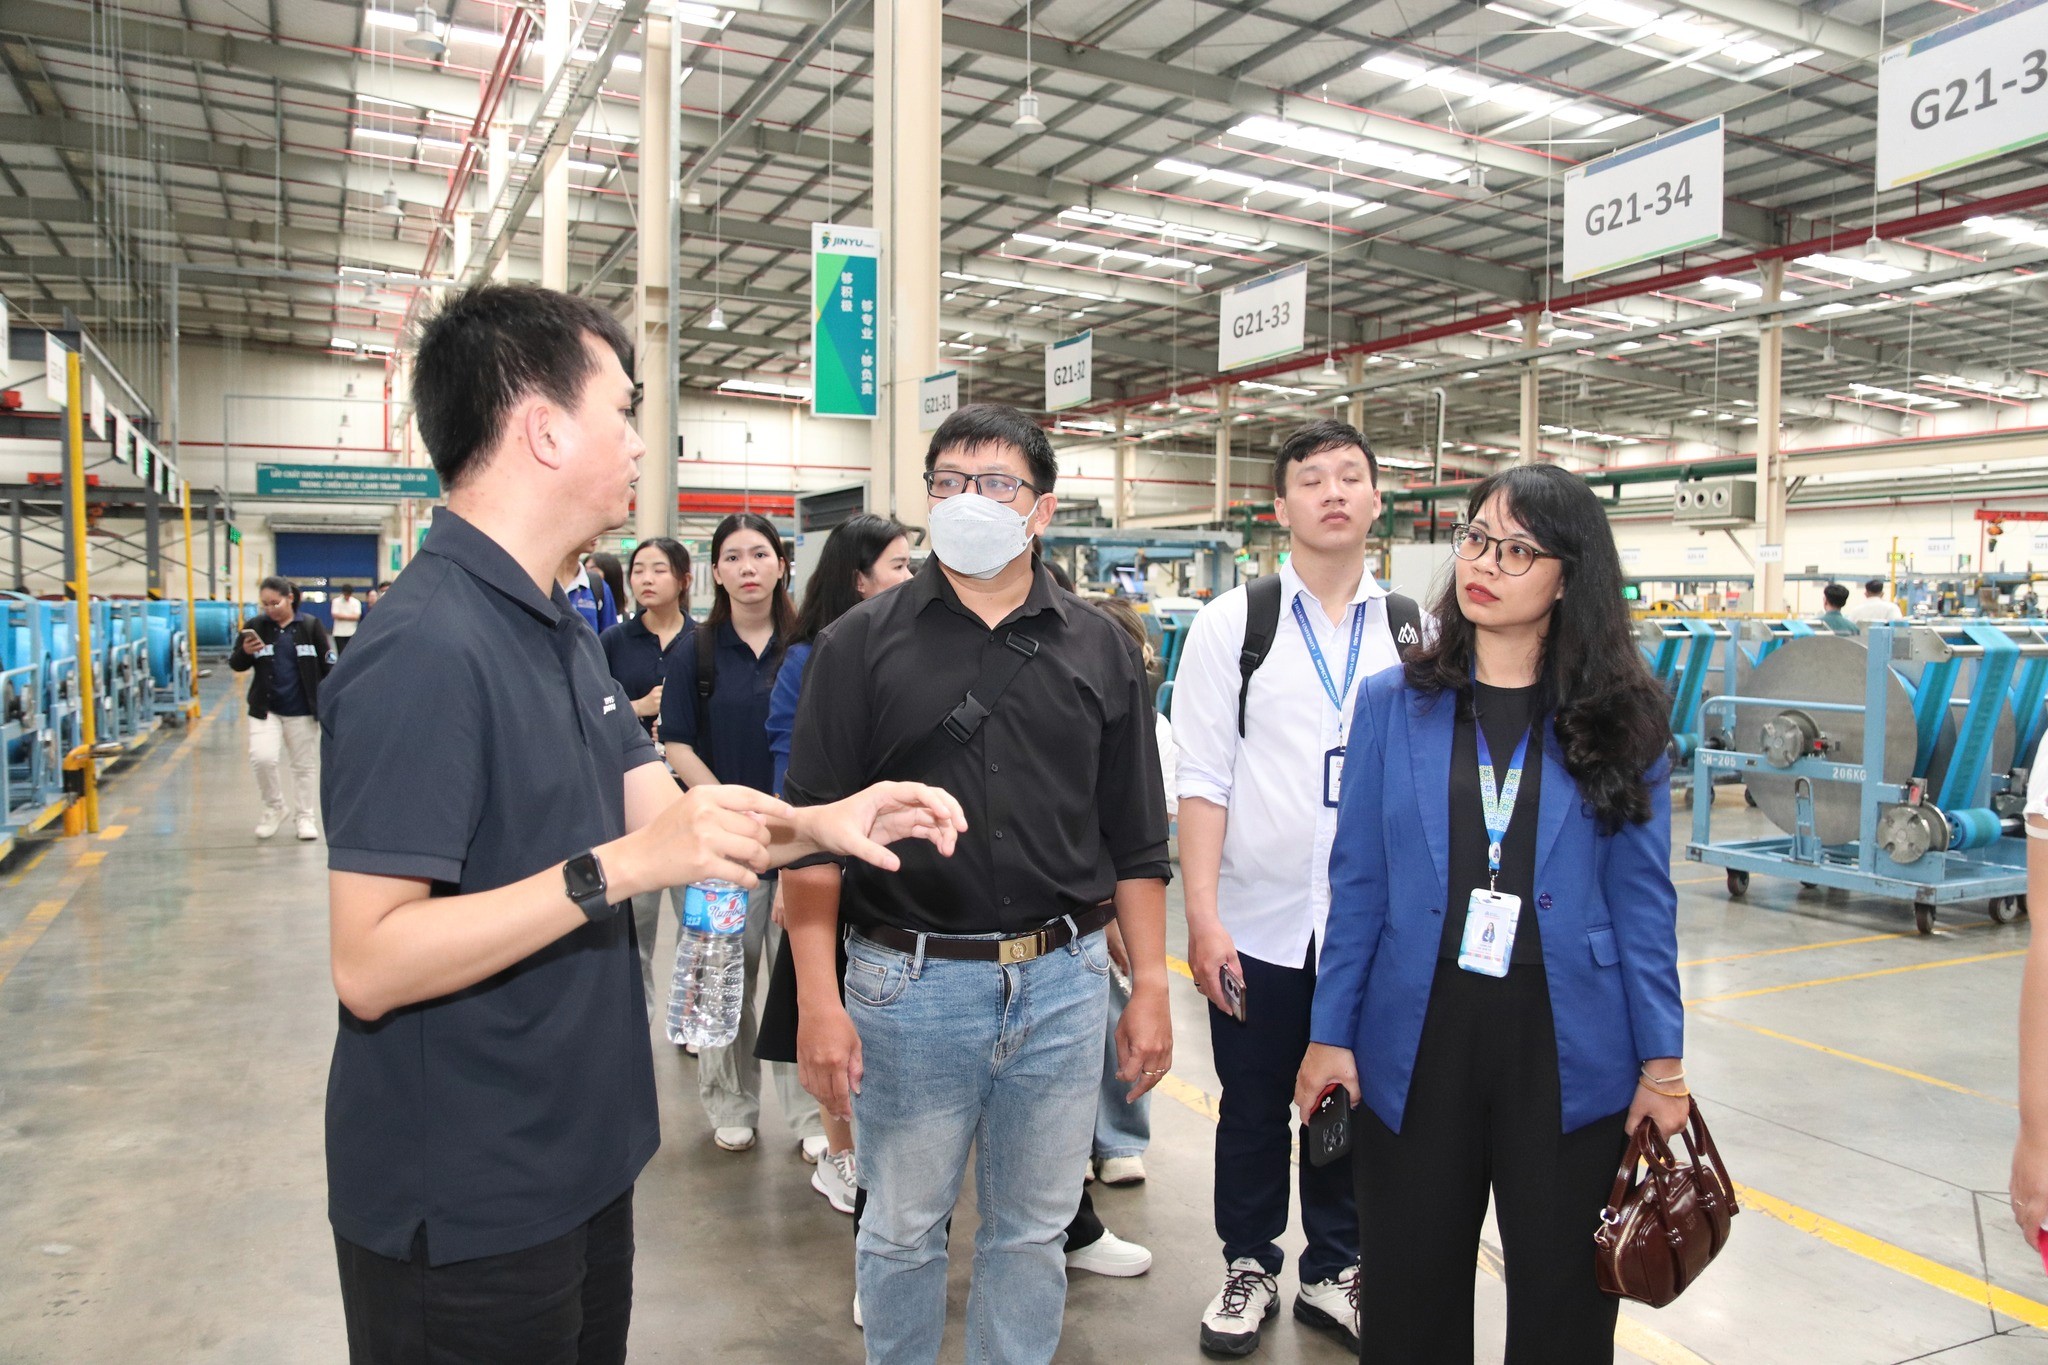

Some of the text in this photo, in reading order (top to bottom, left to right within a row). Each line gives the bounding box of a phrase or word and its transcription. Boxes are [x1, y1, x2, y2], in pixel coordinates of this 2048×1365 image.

[1585, 174, 1693, 236] G21-34
[832, 237, 863, 247] JINYU
[1233, 301, 1290, 339] G21-33
[1053, 360, 1085, 386] G21-32
[924, 394, 951, 414] G21-31
[1302, 623, 1315, 650] UNIVERSITY
[1316, 658, 1328, 679] RESPECT
[1325, 679, 1338, 703] DIVERSITY
[1832, 767, 1867, 781] 206KG
